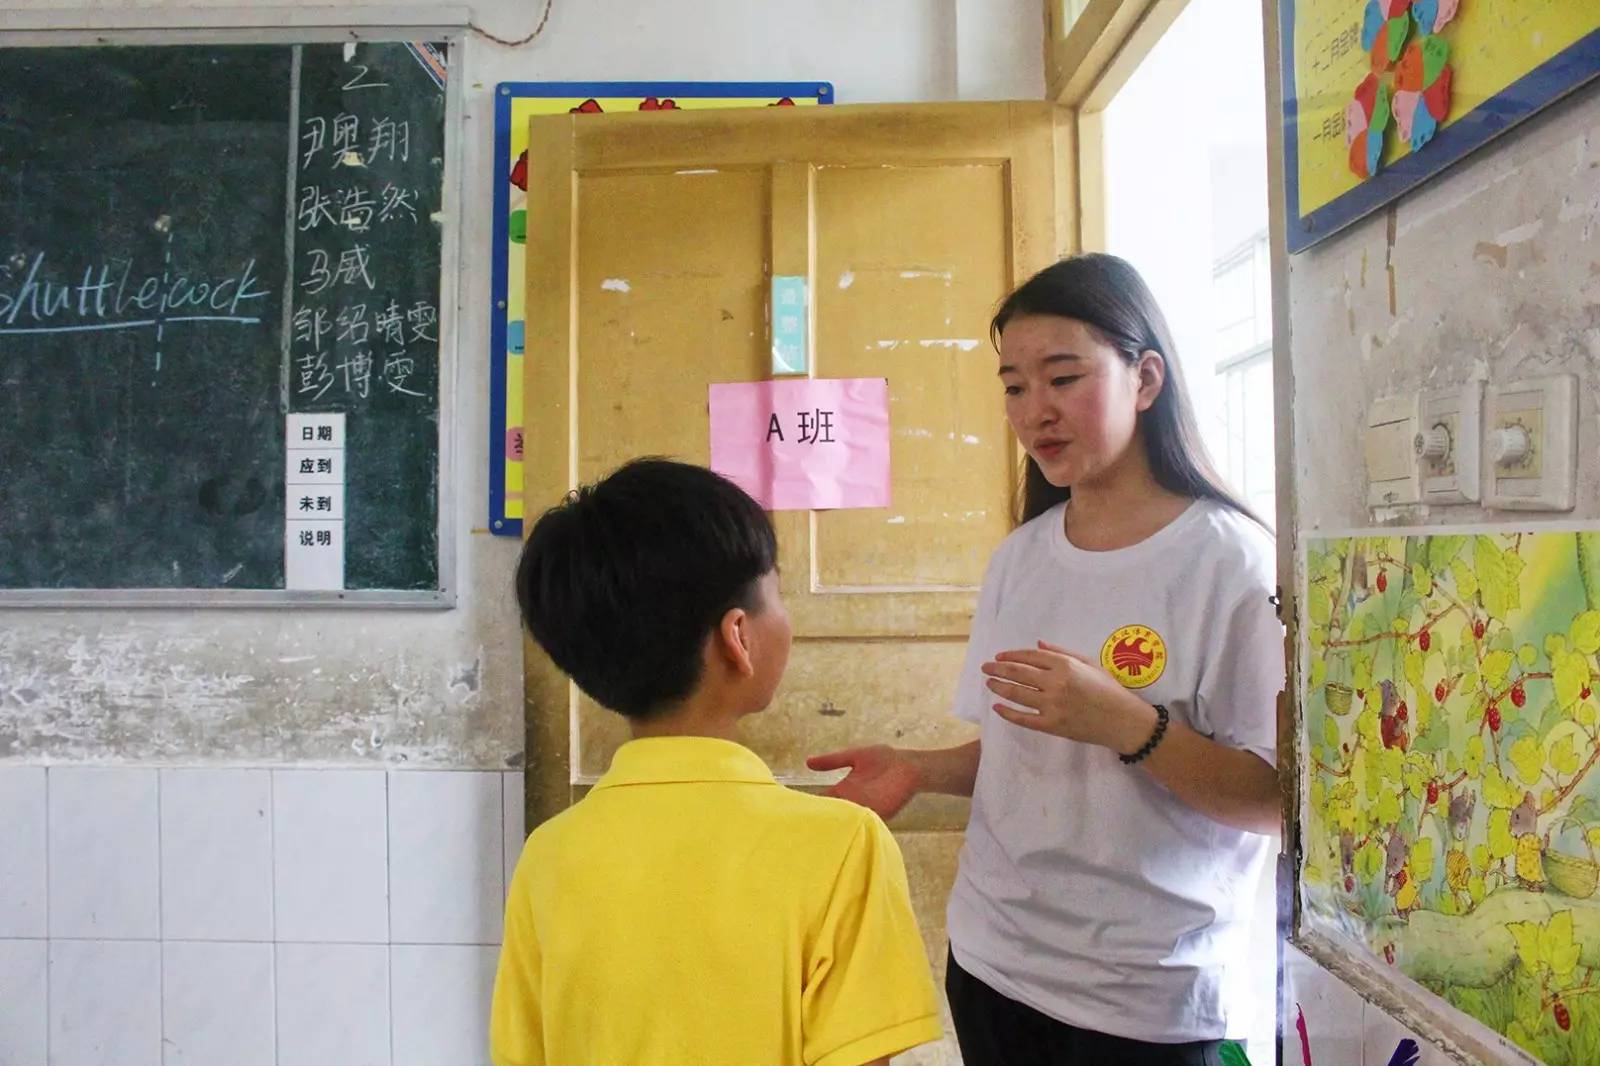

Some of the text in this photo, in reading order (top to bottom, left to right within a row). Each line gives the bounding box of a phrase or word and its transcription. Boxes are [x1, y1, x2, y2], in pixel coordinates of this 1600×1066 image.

[298, 182, 418, 233] 张浩然
[300, 243, 376, 294] 马威
[302, 426, 332, 441] 日期
[766, 408, 835, 445] A 班
[299, 458, 332, 474] 应到
[299, 496, 331, 512] 未到
[299, 530, 331, 546] 说明
